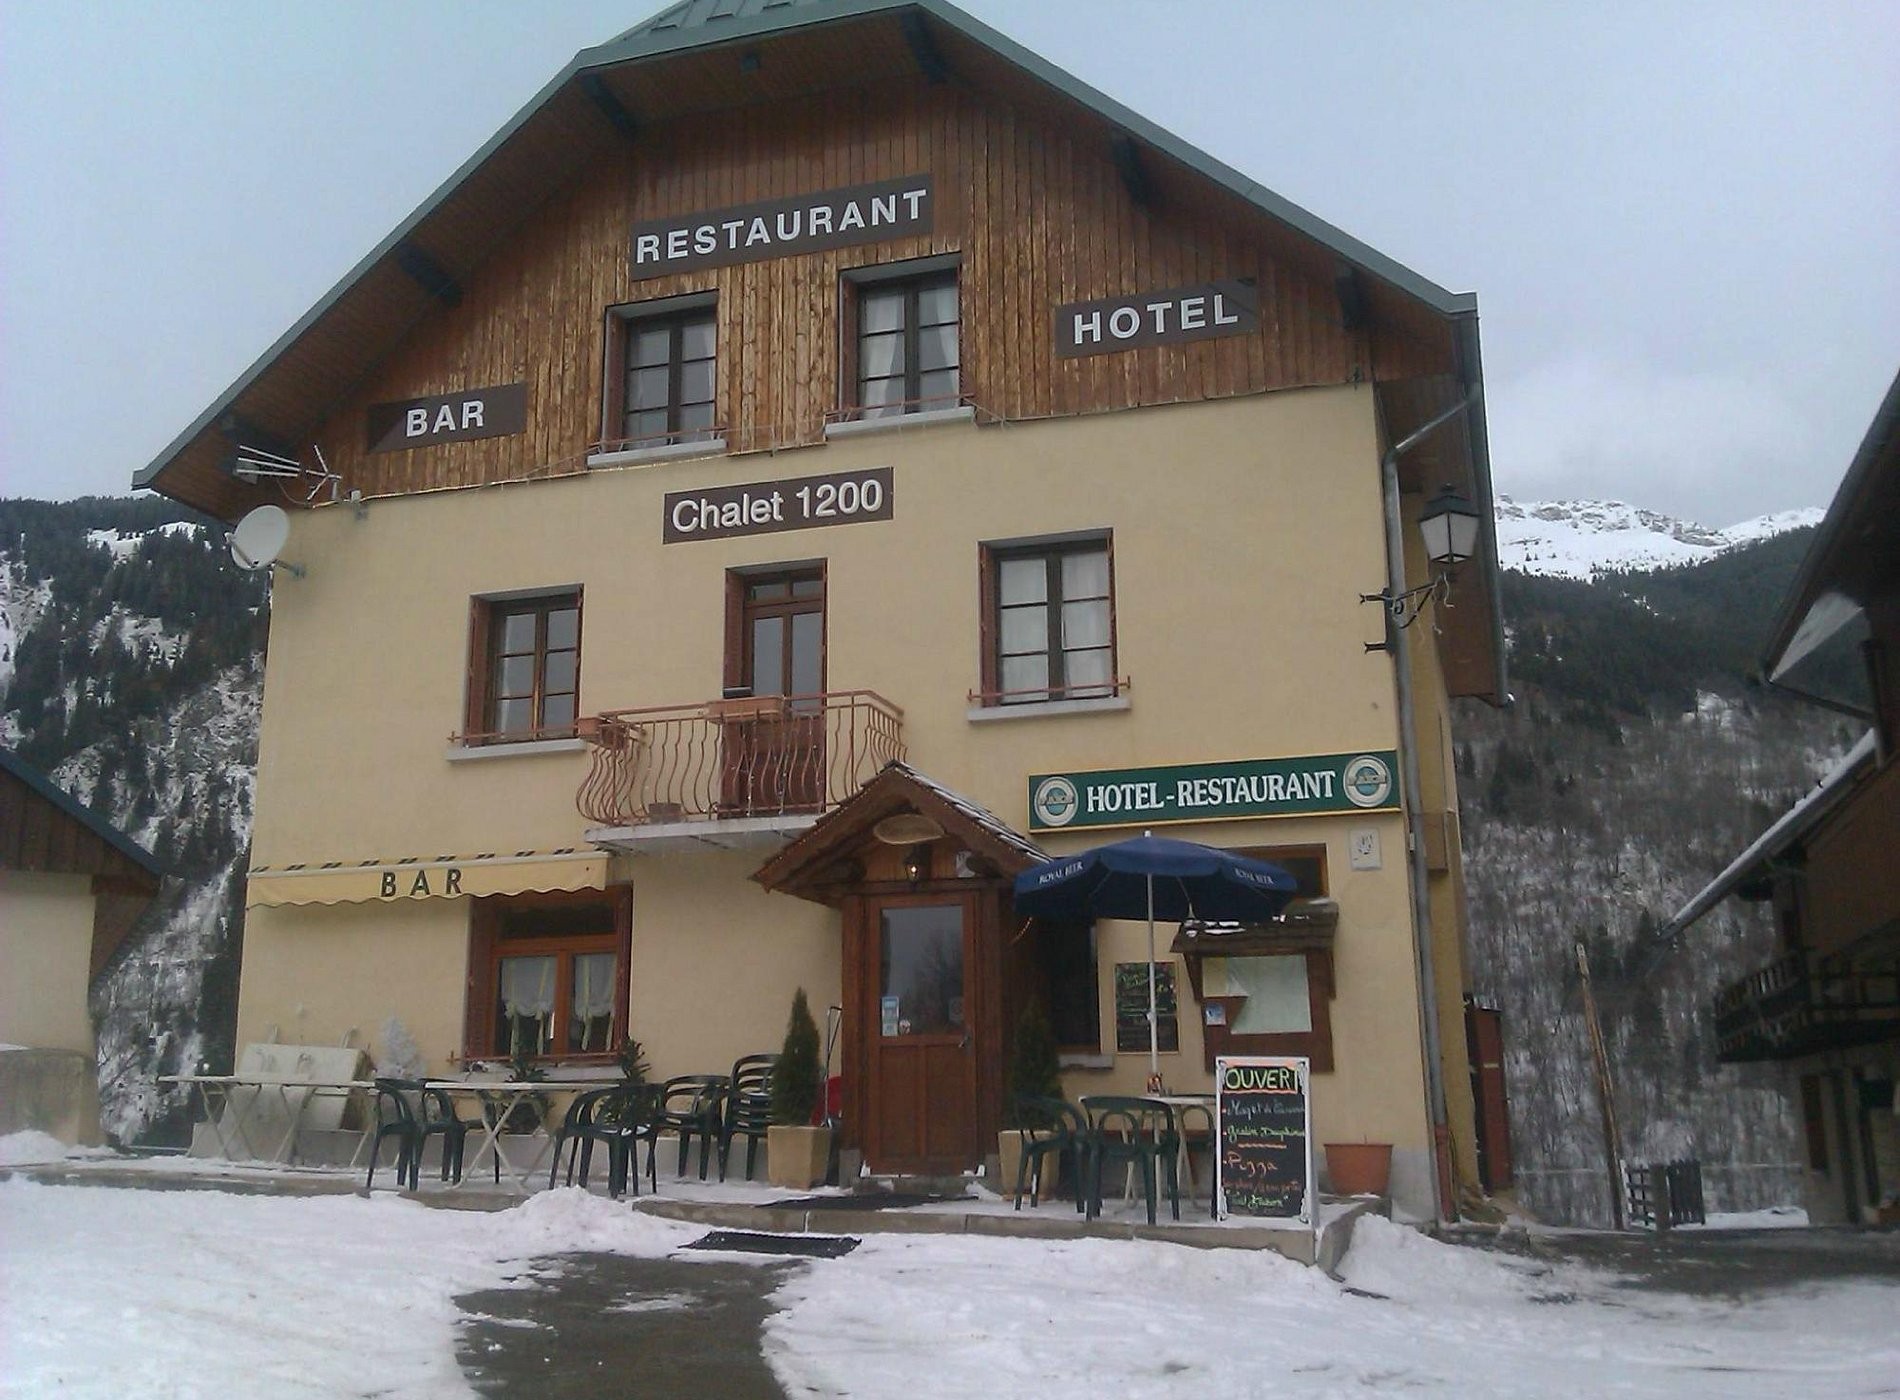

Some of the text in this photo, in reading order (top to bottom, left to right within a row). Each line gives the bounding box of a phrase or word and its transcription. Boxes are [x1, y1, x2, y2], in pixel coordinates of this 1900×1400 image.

[636, 188, 928, 265] RESTAURANT
[1073, 294, 1239, 345] HOTEL
[405, 399, 485, 438] BAR
[671, 478, 884, 533] Chalet 1200
[380, 868, 464, 898] BAR
[1225, 1068, 1300, 1091] OUVERT
